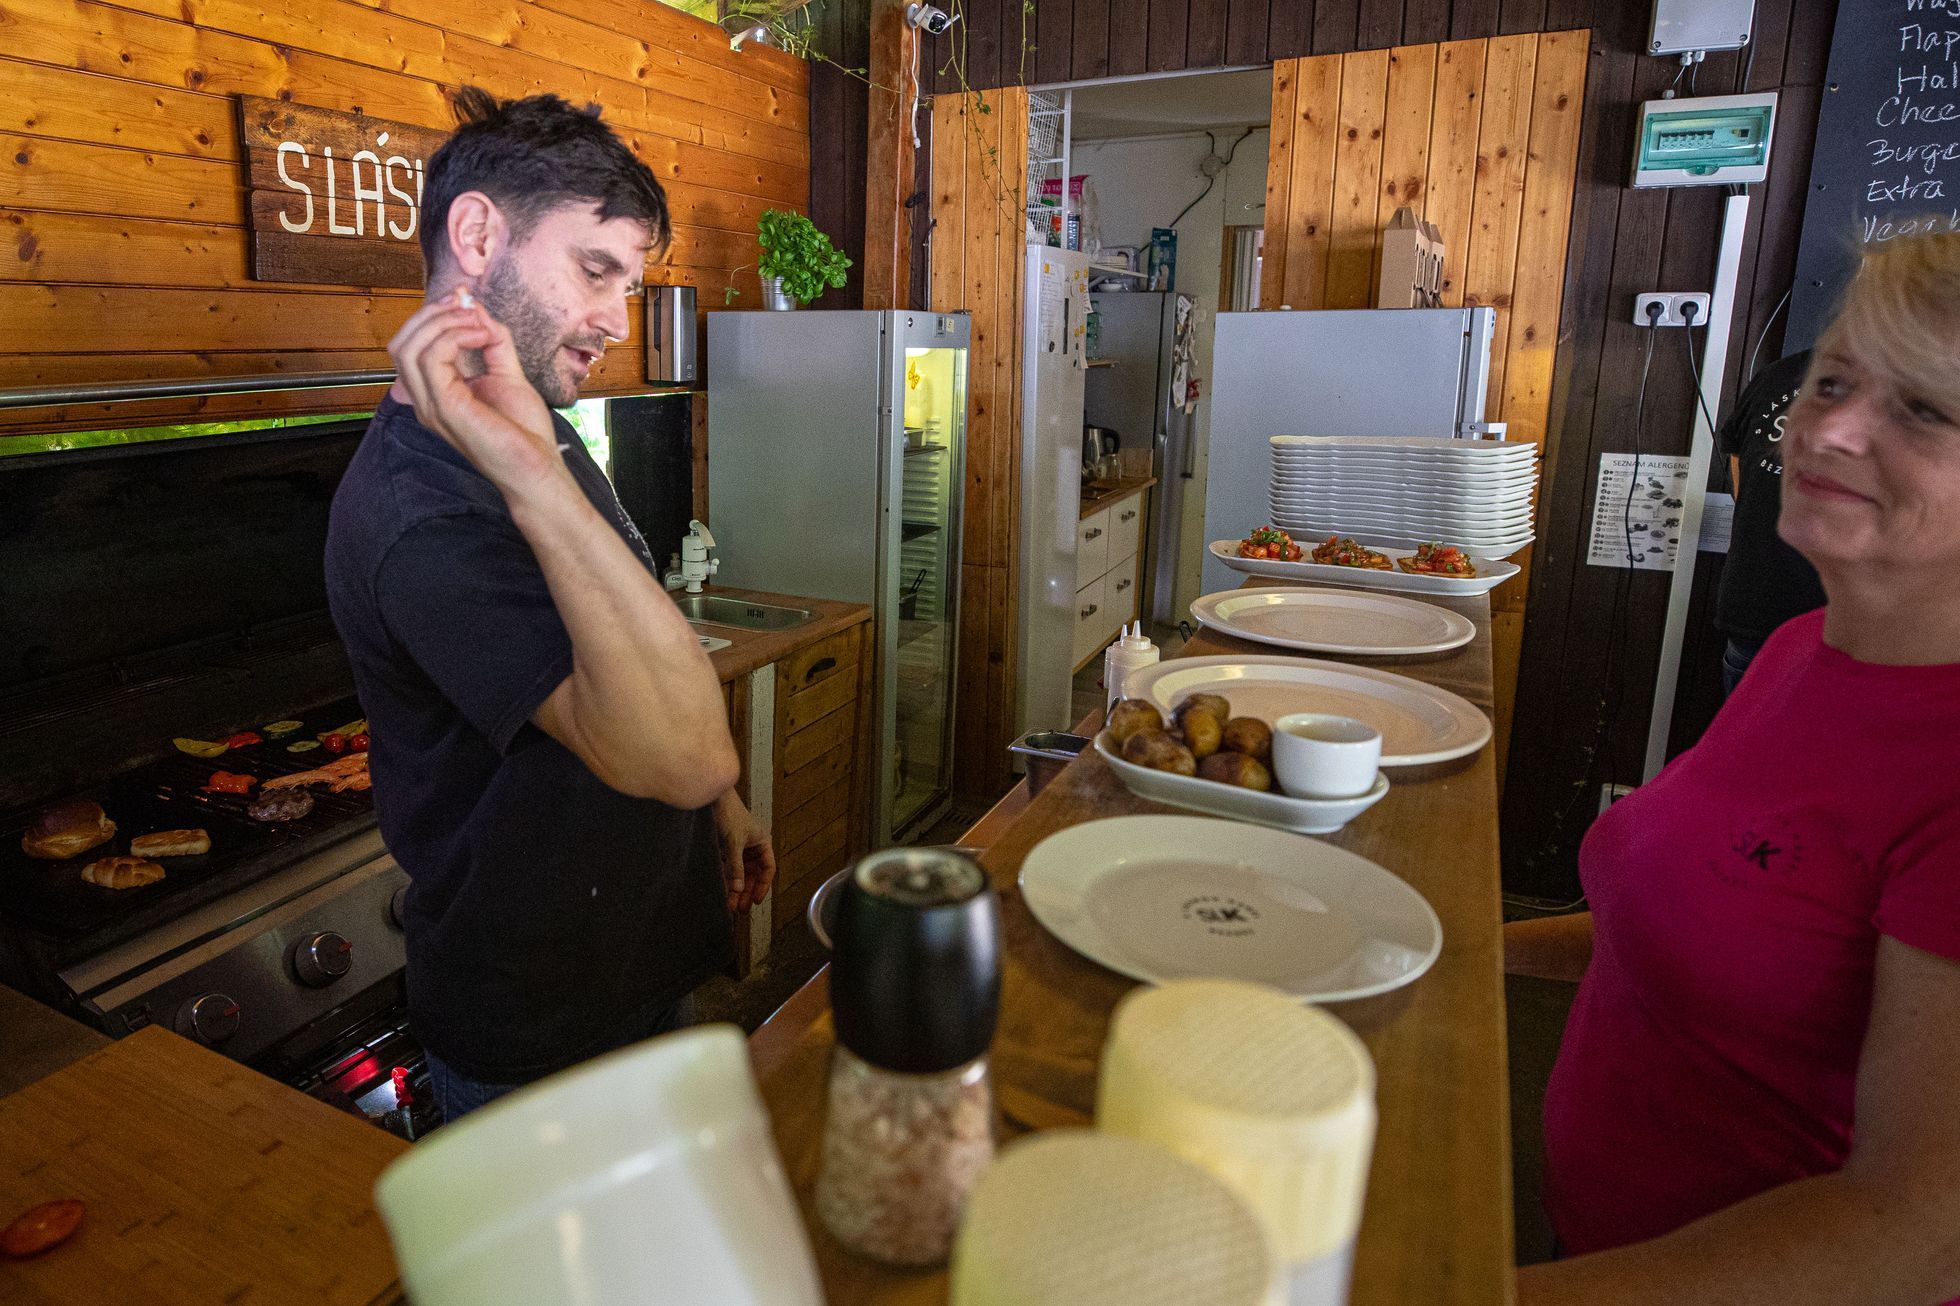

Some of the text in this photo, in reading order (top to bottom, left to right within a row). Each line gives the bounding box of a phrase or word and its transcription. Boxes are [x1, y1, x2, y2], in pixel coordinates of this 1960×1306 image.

[1899, 24, 1960, 61] Flap
[1866, 139, 1960, 174] Burge
[1867, 175, 1946, 202] Extra
[1612, 460, 1646, 468] SEZNAM
[1760, 459, 1784, 475] BEZ
